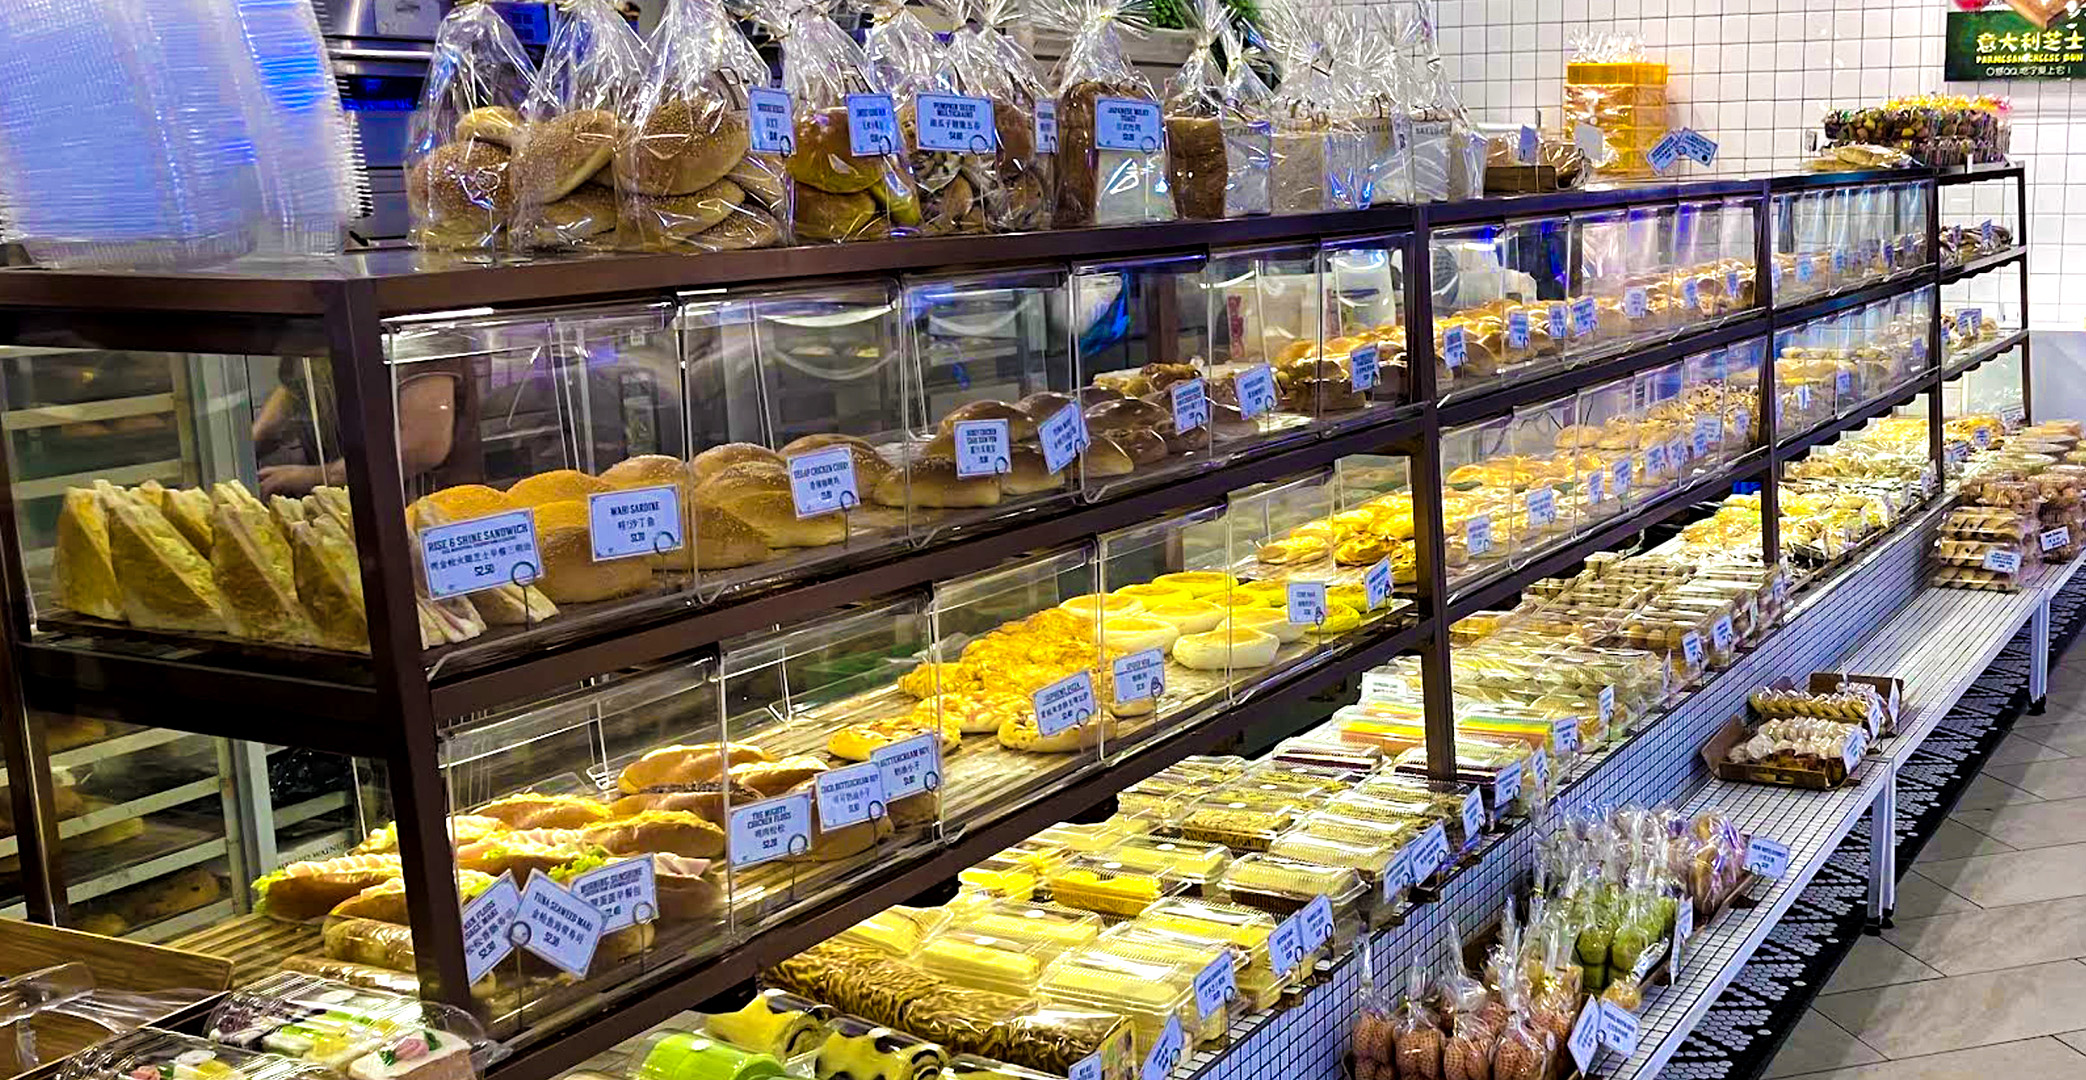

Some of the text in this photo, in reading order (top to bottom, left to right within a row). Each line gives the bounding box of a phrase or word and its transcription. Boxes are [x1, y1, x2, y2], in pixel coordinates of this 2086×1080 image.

[1976, 30, 2086, 53] 意大利芝士
[1976, 53, 2084, 64] PARMESAN CHEESE BUN
[630, 501, 660, 514] SARDINE
[427, 539, 448, 552] RISE
[456, 532, 482, 546] SHINE
[483, 523, 528, 541] SANDWICH
[764, 805, 786, 816] MIGHTY
[748, 811, 791, 829] CHICKEN FLOSS
[534, 892, 593, 932] TUNA SEAWEED MAKI
